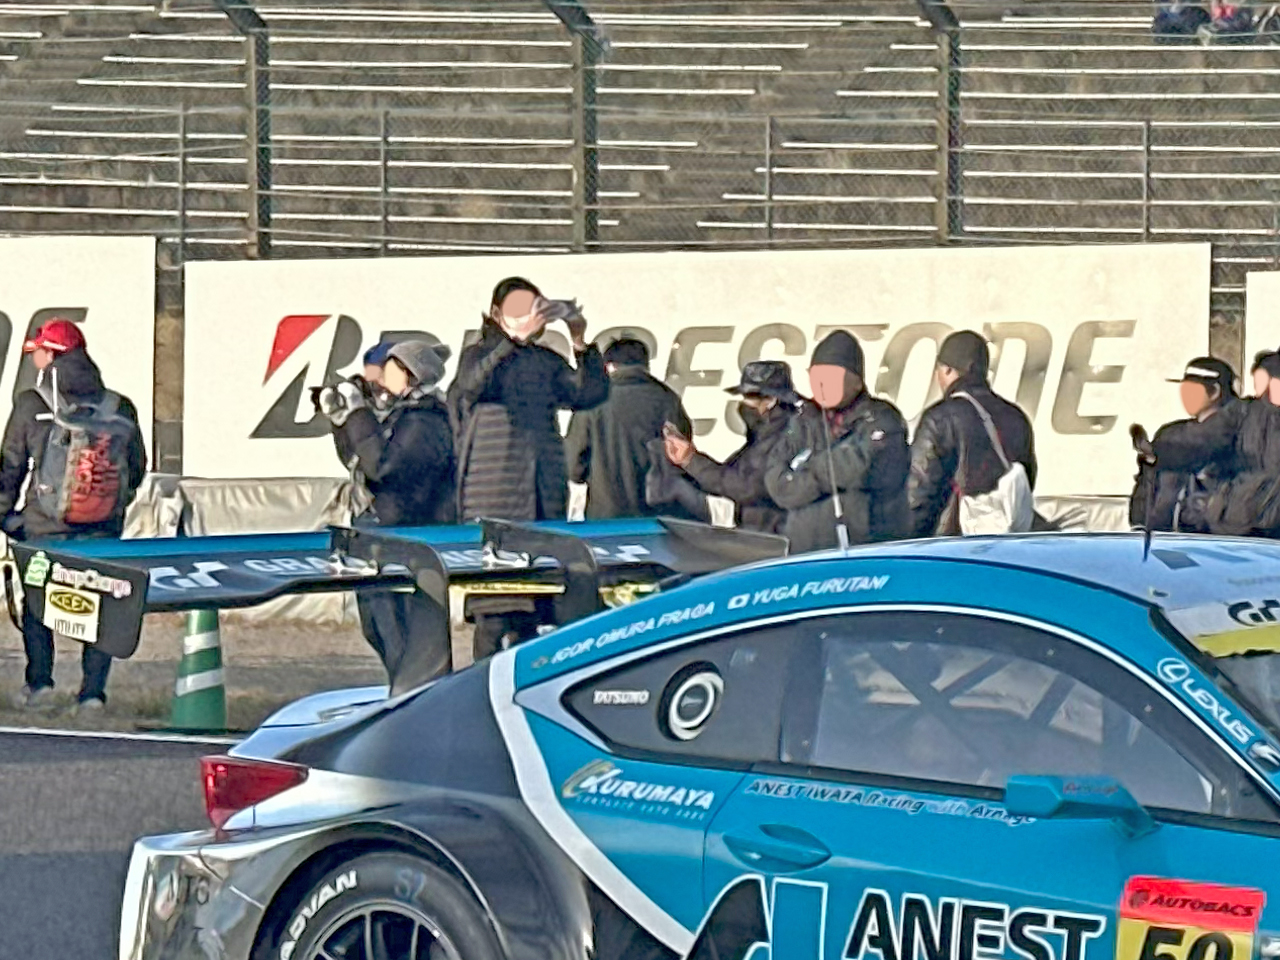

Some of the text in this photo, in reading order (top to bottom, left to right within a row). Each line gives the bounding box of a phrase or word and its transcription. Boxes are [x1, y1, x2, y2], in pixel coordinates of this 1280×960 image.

[50, 592, 96, 612] KEEN
[751, 574, 892, 606] YUGA FURUTANI
[595, 619, 655, 649] OMURA
[1181, 678, 1256, 745] LEXUS
[578, 768, 715, 810] KURUMAYA
[746, 779, 806, 798] ANEST
[806, 784, 862, 804] IWATA
[866, 792, 926, 814] Racing
[1150, 894, 1256, 917] AUTOBACS
